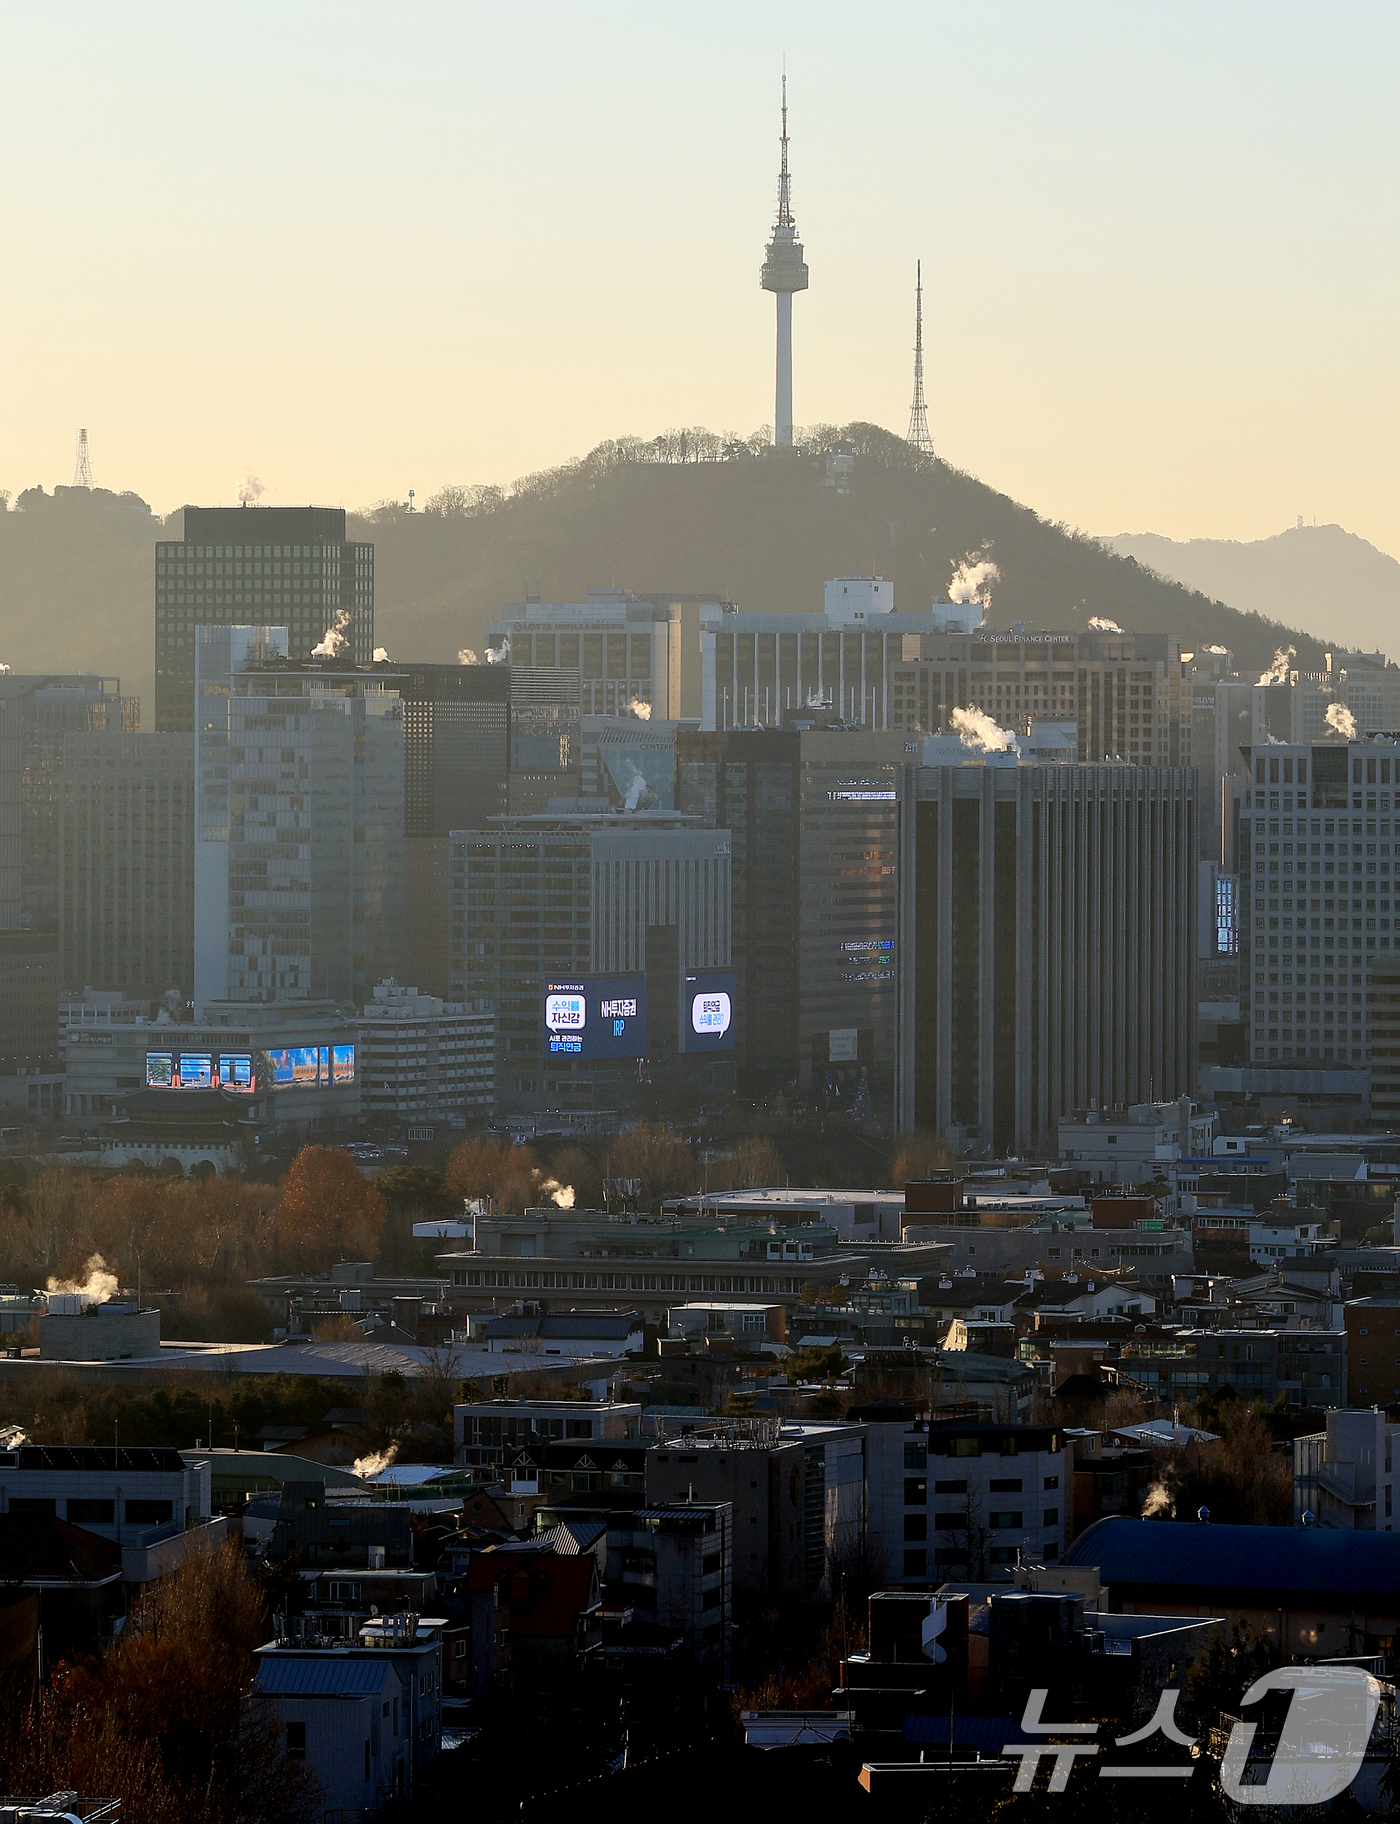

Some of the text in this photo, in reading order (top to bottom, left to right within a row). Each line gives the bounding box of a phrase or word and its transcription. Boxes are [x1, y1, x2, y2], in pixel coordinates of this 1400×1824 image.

[523, 622, 554, 631] LOTTE
[990, 634, 1012, 643] SEOUL
[1014, 634, 1043, 643] FINANCE
[1044, 634, 1070, 643] CENTER
[601, 998, 637, 1018] NH투자증권
[613, 1019, 625, 1037] IRP
[550, 1042, 582, 1052] 퇴직연금
